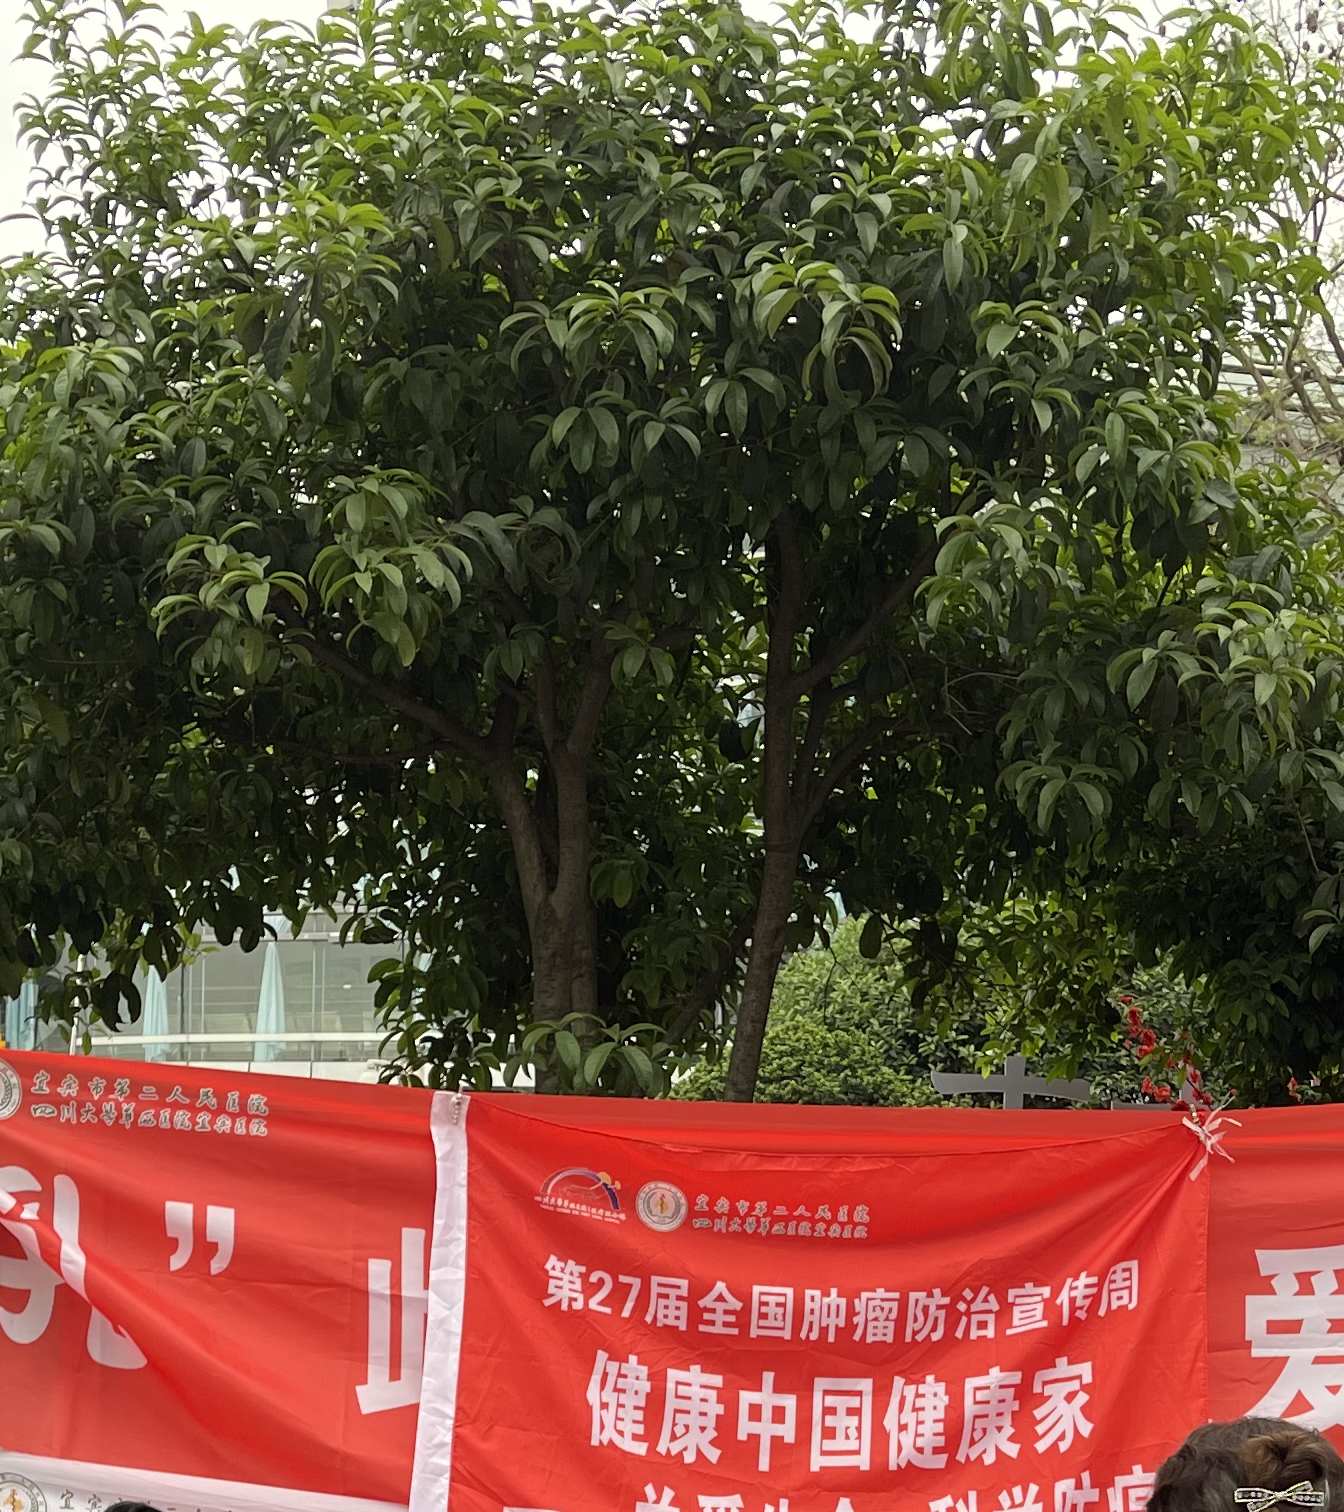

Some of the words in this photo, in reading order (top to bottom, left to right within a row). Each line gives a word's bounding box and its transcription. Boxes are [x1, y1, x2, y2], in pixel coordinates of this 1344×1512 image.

[542, 1252, 1140, 1345] 第27届全国肿瘤防治宣传周
[586, 1349, 1096, 1473] 健康中国健康家
